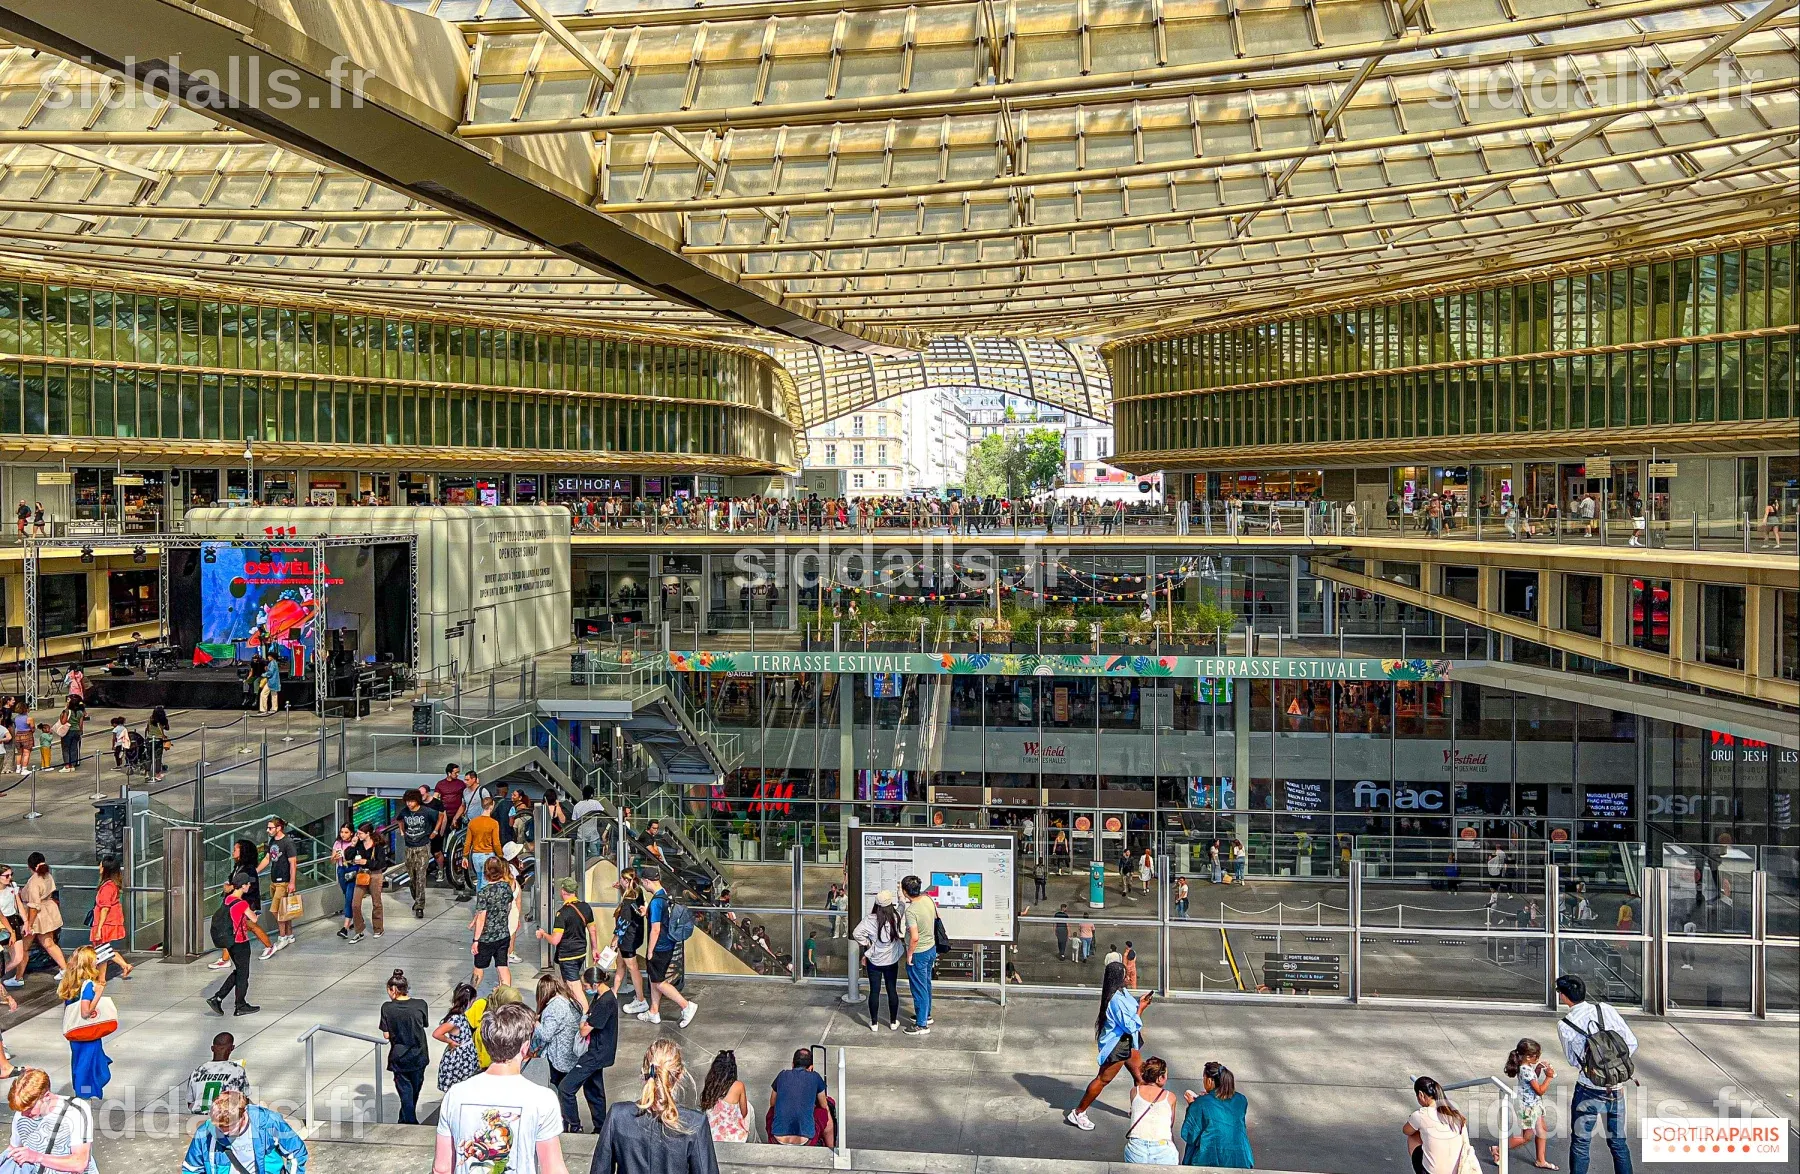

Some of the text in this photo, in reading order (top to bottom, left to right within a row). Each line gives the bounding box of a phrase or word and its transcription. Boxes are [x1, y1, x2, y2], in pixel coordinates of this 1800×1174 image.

[558, 478, 621, 490] SEPHORA
[752, 655, 912, 672] TERRASSE ESTIVALE
[1196, 660, 1368, 678] TERRASSE ESTIVALE
[1301, 783, 1321, 791] LIVRE
[1353, 780, 1444, 810] fnac
